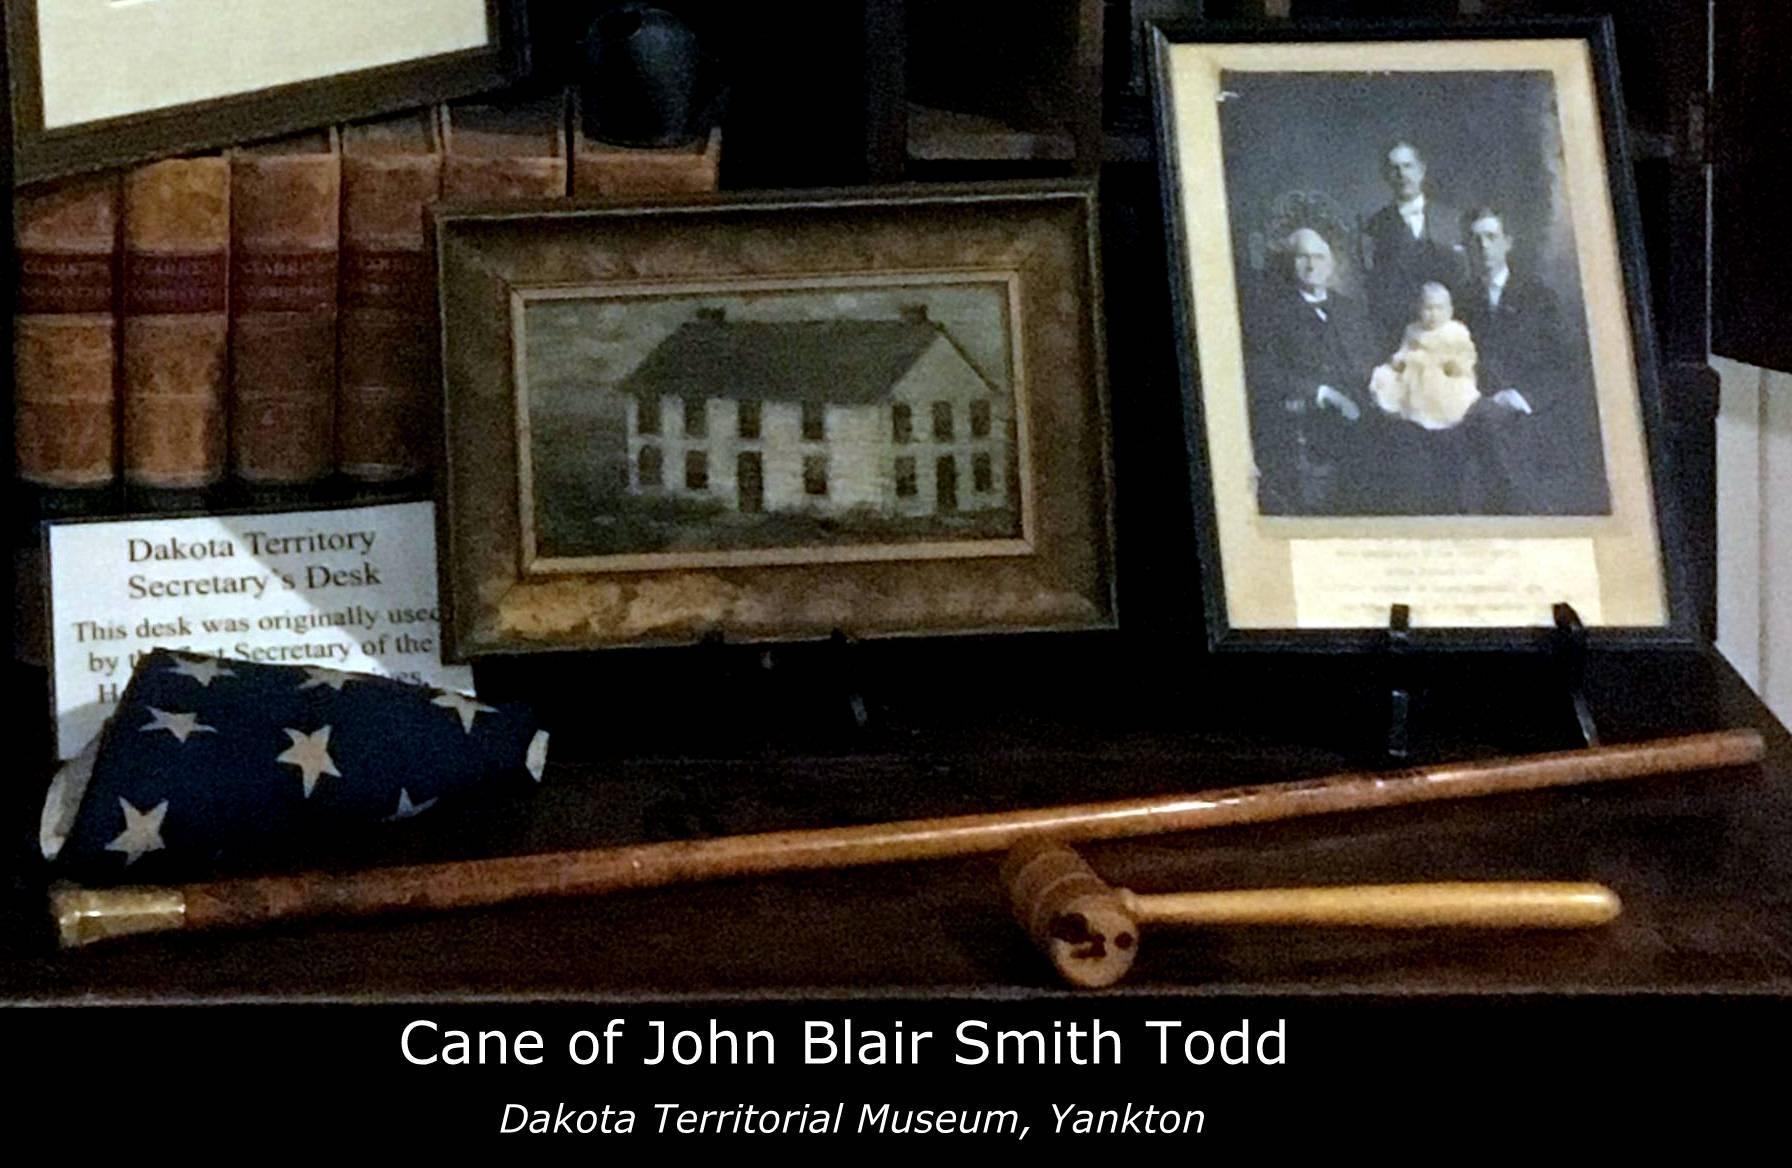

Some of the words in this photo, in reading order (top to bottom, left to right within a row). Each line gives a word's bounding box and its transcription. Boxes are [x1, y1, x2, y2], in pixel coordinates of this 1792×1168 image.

[128, 536, 235, 562] Dakota
[244, 529, 376, 556] Territory
[306, 561, 383, 590] Desk
[74, 620, 128, 642] This
[135, 616, 193, 638] desk
[202, 616, 251, 633] was
[258, 605, 377, 635] originally
[89, 652, 119, 676] by
[233, 641, 350, 662] Secretary
[362, 633, 389, 656] of
[395, 633, 433, 652] the
